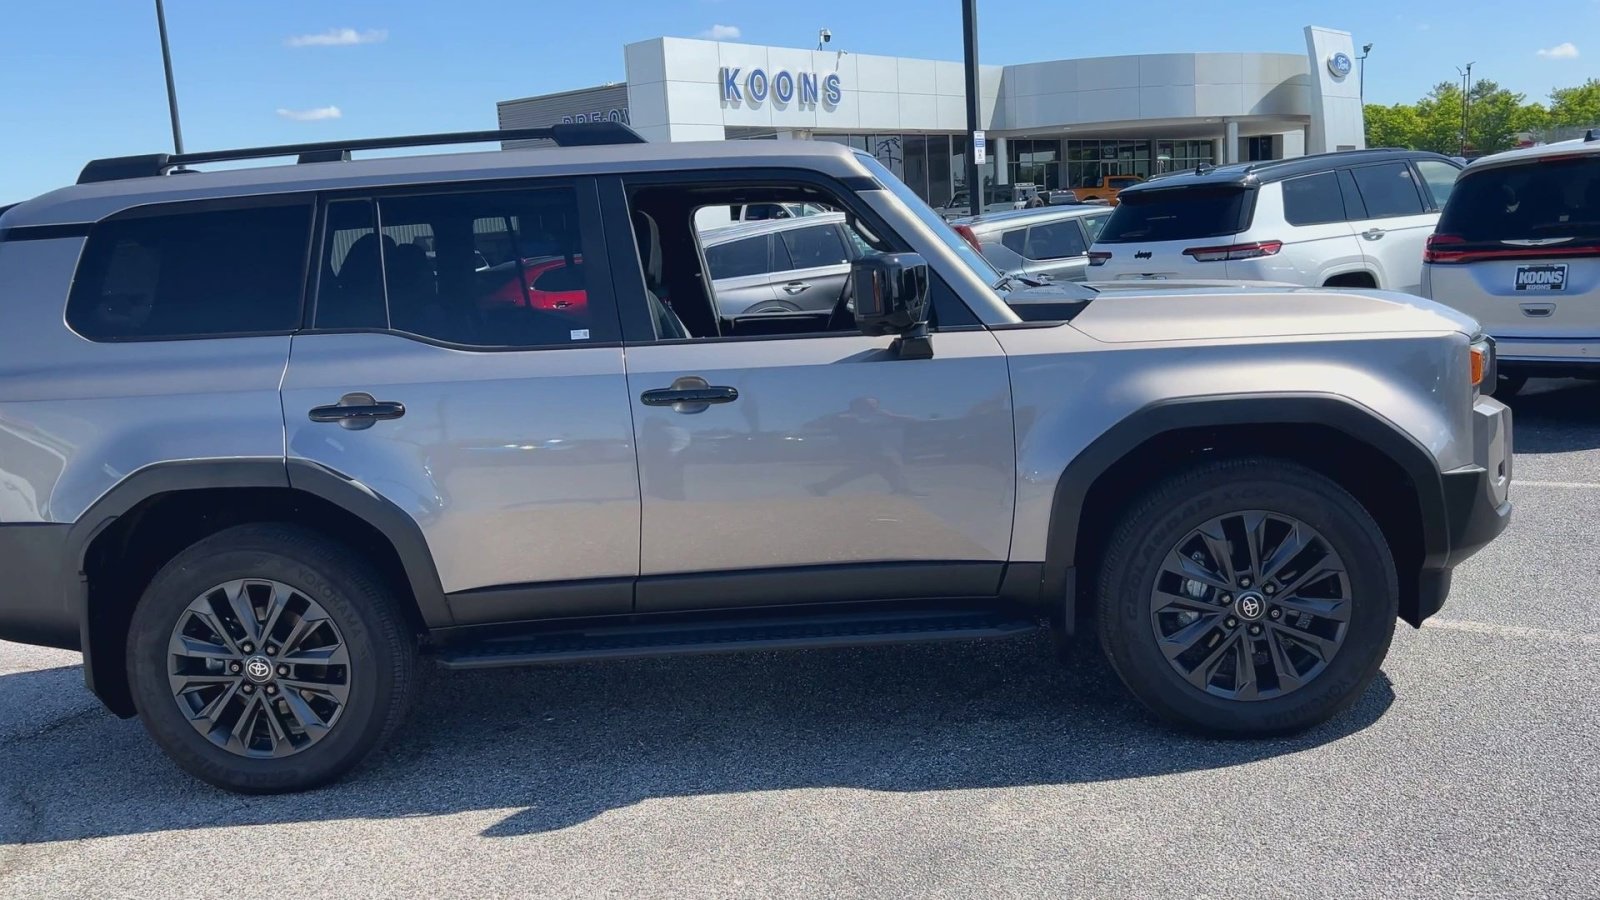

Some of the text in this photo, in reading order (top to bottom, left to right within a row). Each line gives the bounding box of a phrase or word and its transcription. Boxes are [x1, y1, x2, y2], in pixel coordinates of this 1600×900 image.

[721, 67, 842, 106] KOONS
[1134, 250, 1152, 260] Jeep
[1518, 270, 1563, 284] KOONS
[297, 566, 361, 639] YOKOHAMA
